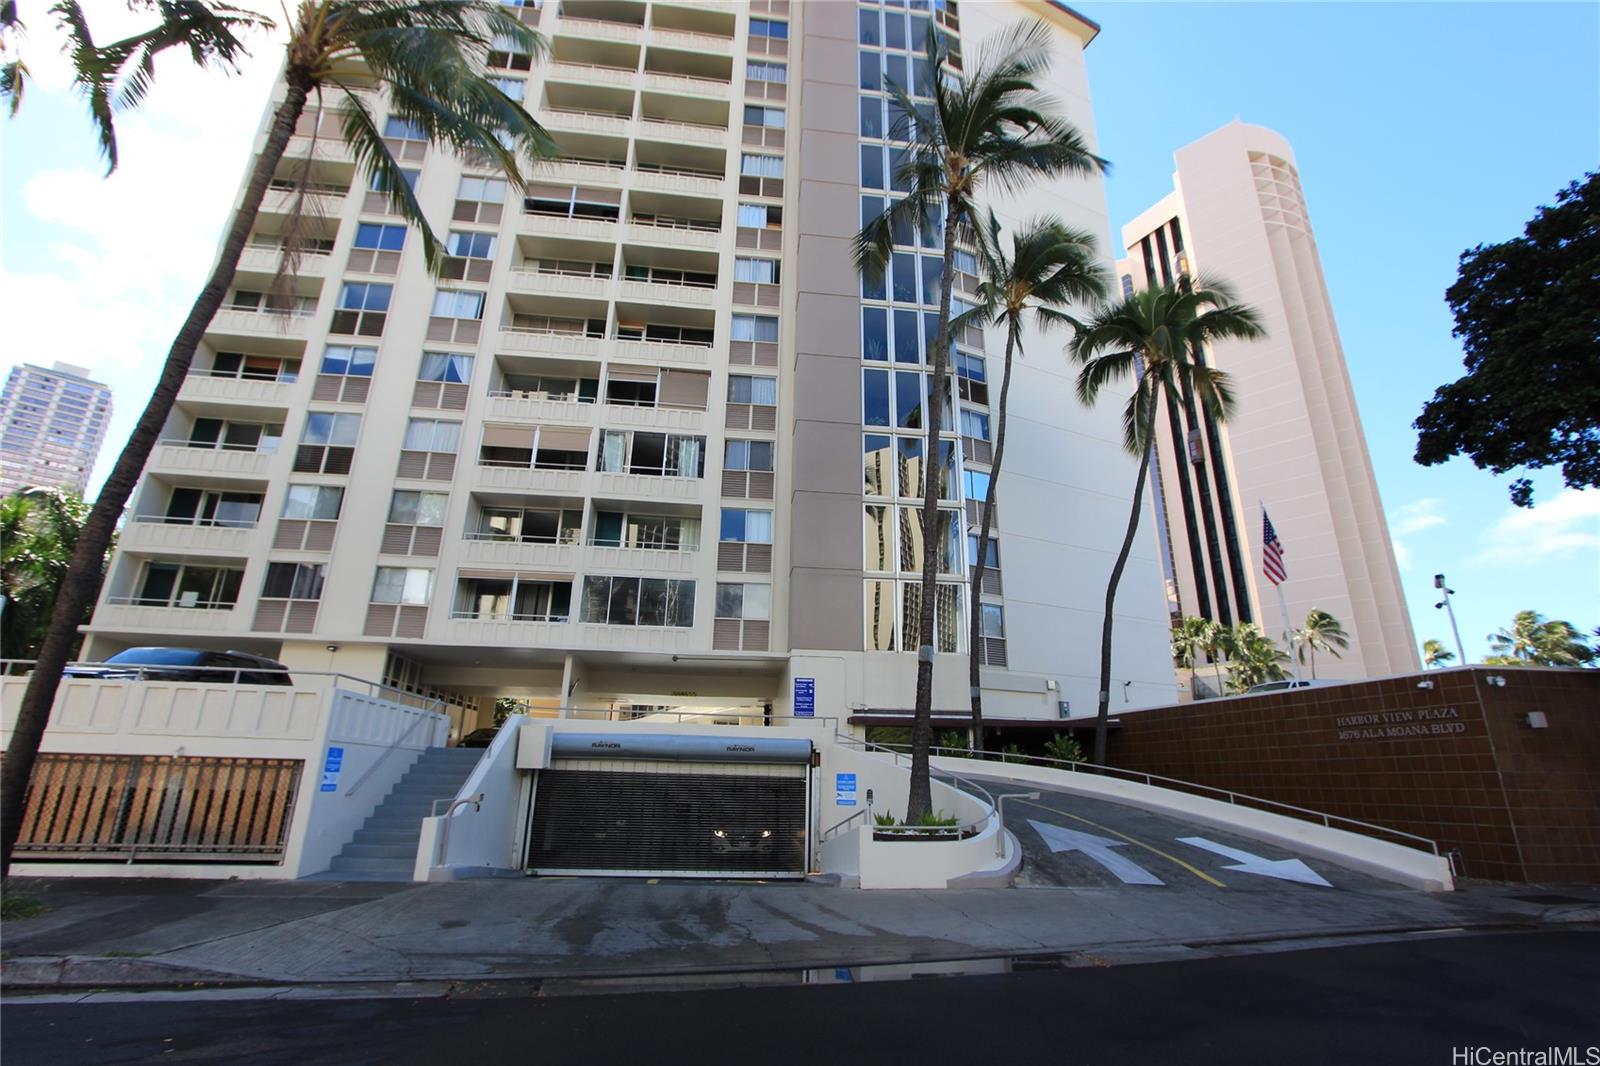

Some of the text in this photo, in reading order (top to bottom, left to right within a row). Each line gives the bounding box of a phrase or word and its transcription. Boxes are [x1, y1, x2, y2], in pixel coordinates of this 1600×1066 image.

[1336, 707, 1459, 727] HARBOR VIEW PLAZA
[1362, 728, 1385, 738] ALA
[1386, 725, 1430, 737] MOANA
[1431, 722, 1465, 734] BLVD
